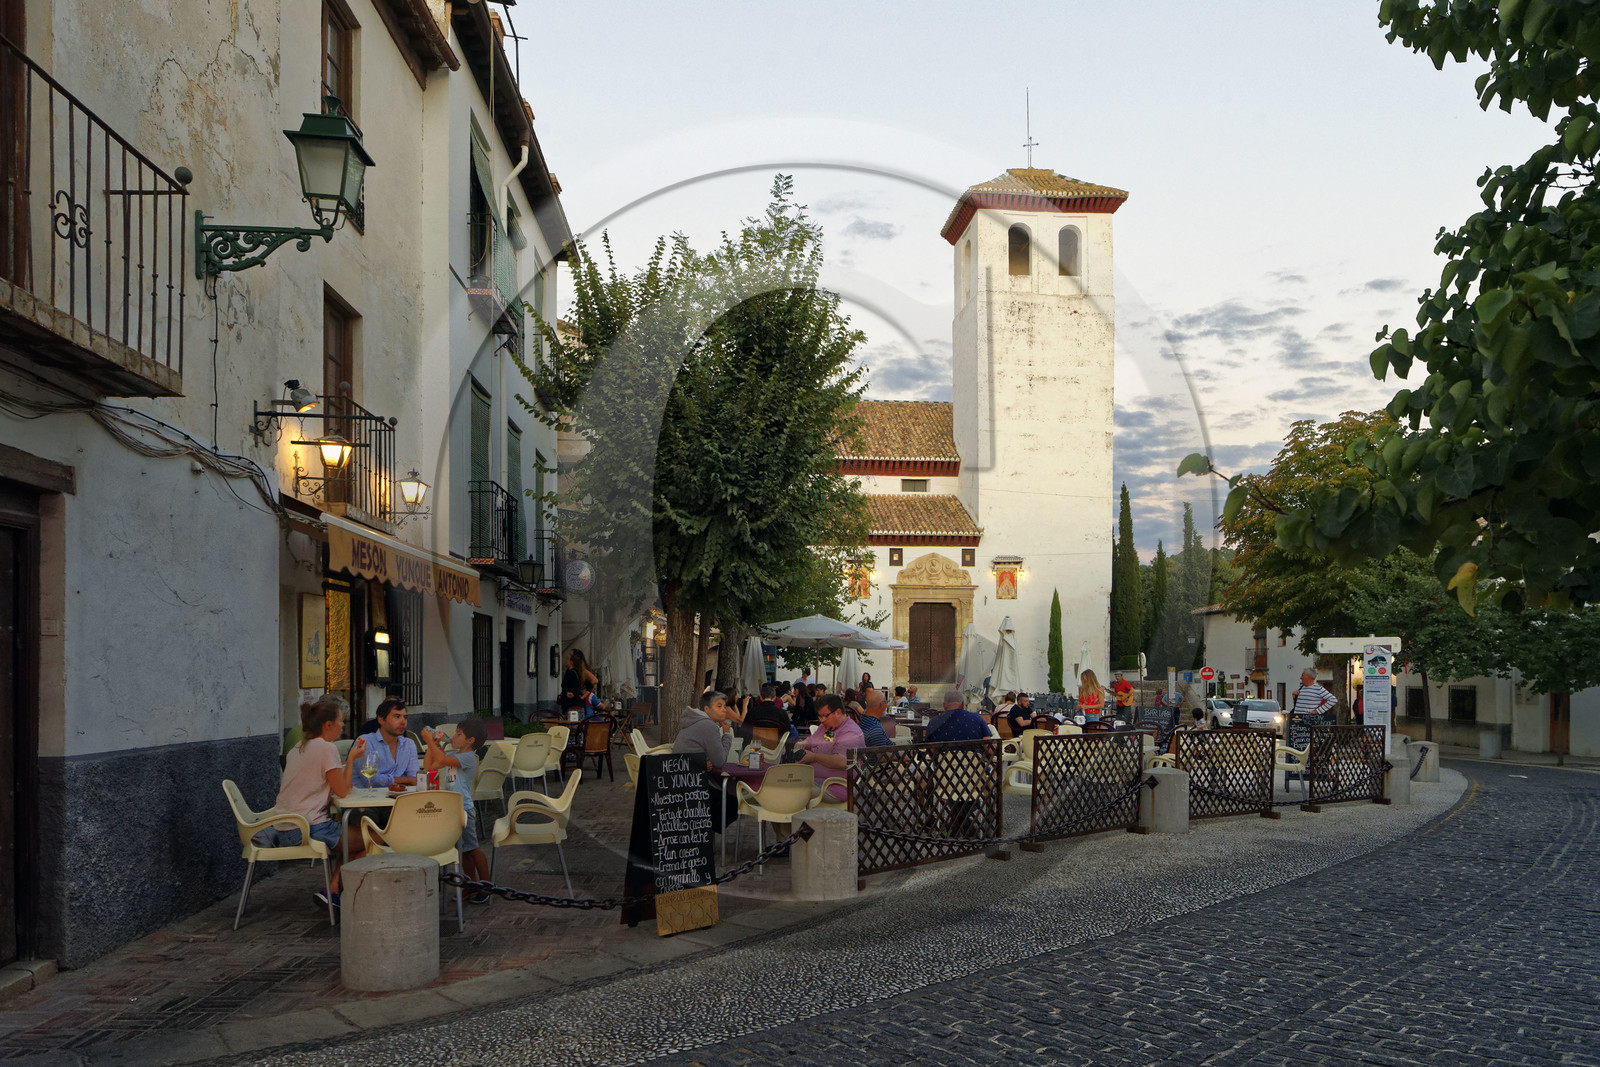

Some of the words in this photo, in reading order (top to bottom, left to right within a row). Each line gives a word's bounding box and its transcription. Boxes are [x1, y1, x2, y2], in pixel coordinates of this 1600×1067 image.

[395, 554, 432, 588] YUNQUE
[438, 569, 470, 599] ANTONIO
[685, 789, 711, 807] postres
[683, 801, 712, 819] chocolate
[679, 834, 692, 845] con
[691, 830, 710, 844] leche
[678, 846, 700, 858] casero
[687, 856, 708, 872] queso
